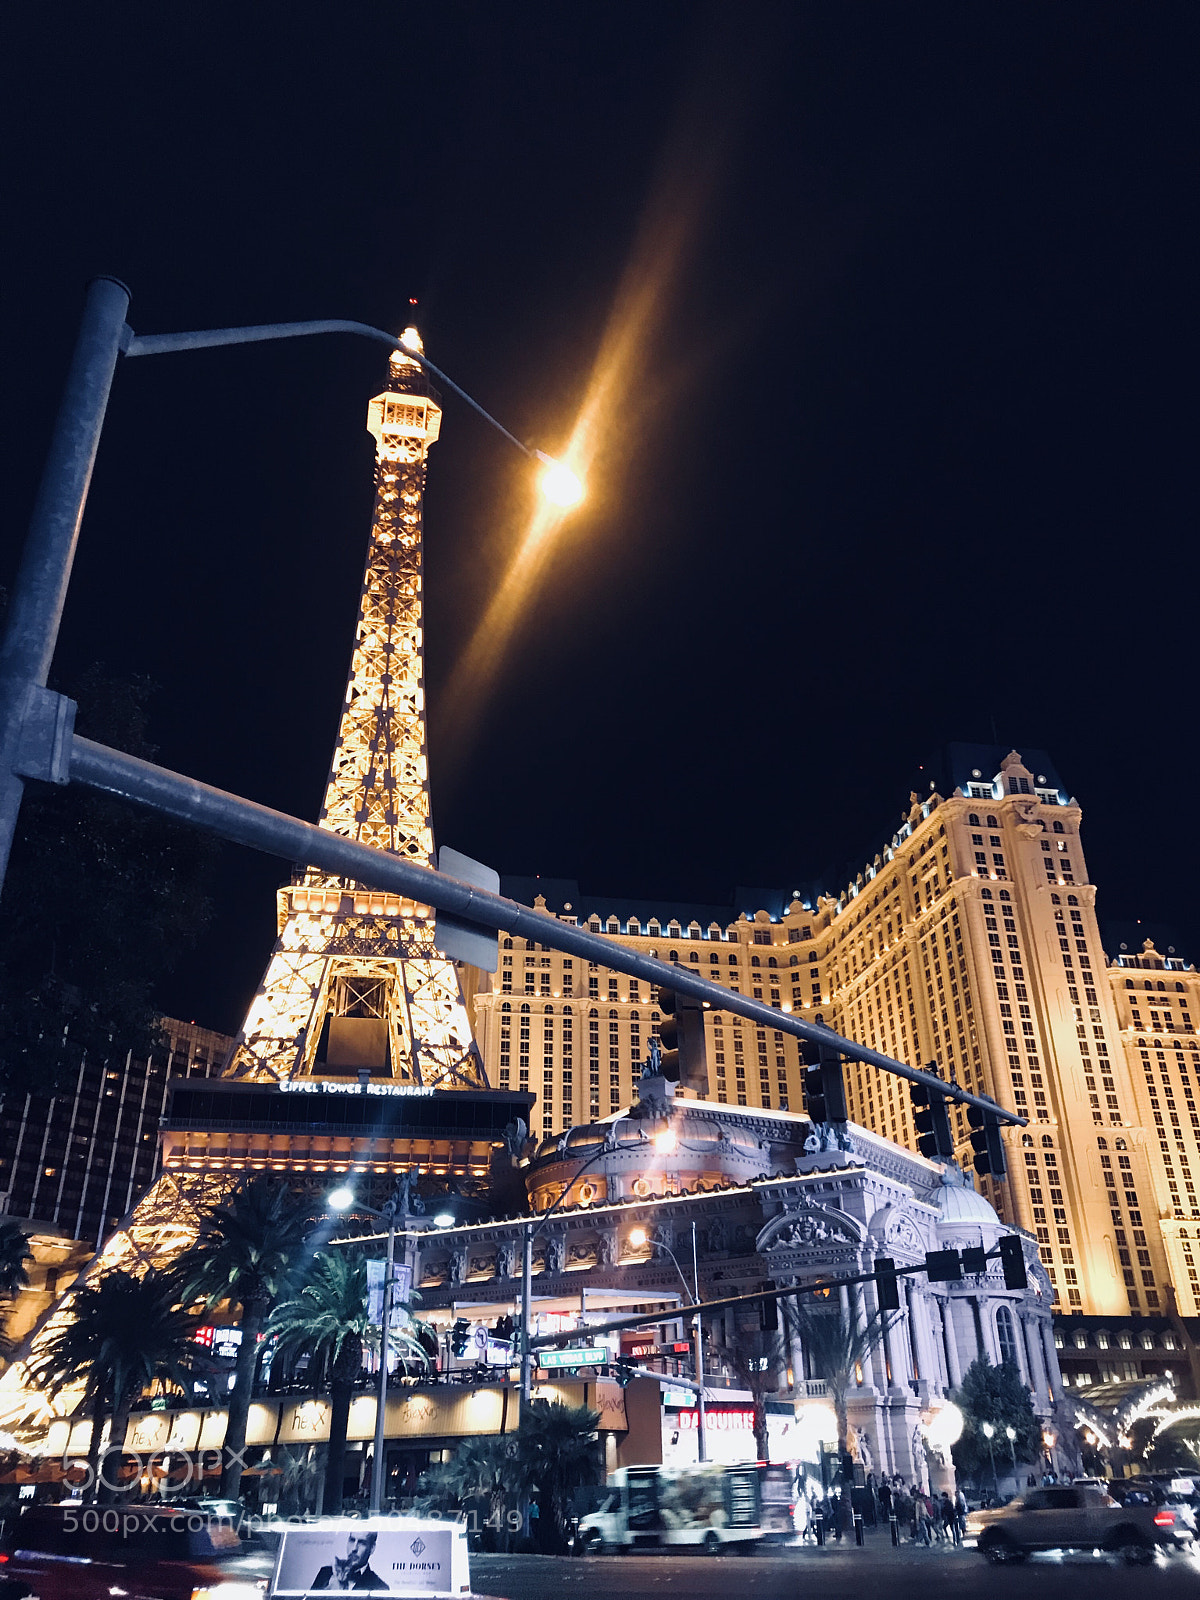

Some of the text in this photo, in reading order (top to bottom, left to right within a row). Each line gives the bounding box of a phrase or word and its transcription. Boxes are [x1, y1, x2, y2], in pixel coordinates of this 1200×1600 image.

[279, 1081, 435, 1097] EIFFEL TOWER RESTAURANT
[542, 1351, 604, 1365] LAS VEGAS BLVD
[392, 1562, 441, 1570] THE DORSEY
